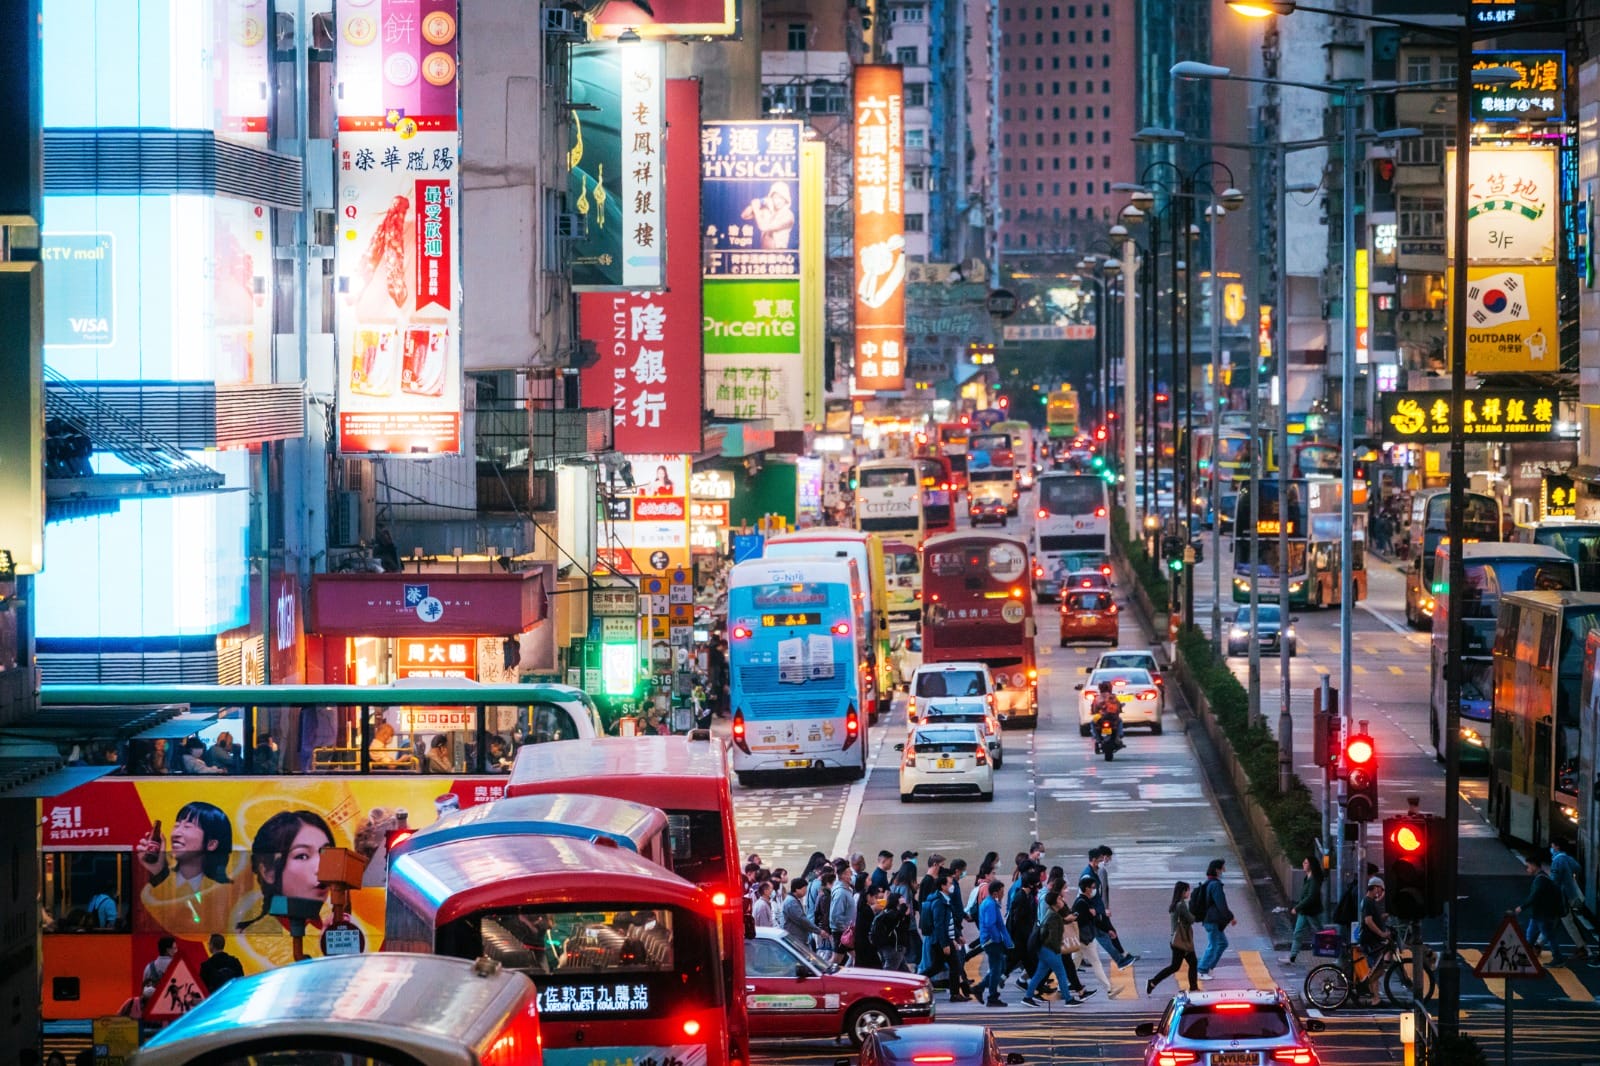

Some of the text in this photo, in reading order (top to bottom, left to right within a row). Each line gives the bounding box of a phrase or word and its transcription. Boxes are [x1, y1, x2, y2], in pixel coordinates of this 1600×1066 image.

[857, 95, 887, 215] 六福珠寶
[632, 101, 656, 248] 老鳳祥銀樓
[703, 161, 796, 177] HYSICAL
[424, 186, 441, 256] 最受歡迎
[1488, 230, 1514, 249] 3/F
[42, 245, 105, 260] KTV mall
[753, 298, 795, 318] 實惠
[69, 318, 109, 333] VISA
[703, 317, 795, 337] Pricerite
[1469, 333, 1521, 344] OUTDARK
[613, 298, 627, 427] LUNG BANK
[630, 291, 667, 427] 隆銀行
[866, 501, 911, 513] CITIZEN
[408, 644, 467, 663] 周大福
[651, 675, 672, 685] S16
[474, 786, 503, 798] 奧樂
[42, 806, 82, 830] 気!
[544, 984, 648, 1003] 佐敦西九龍站
